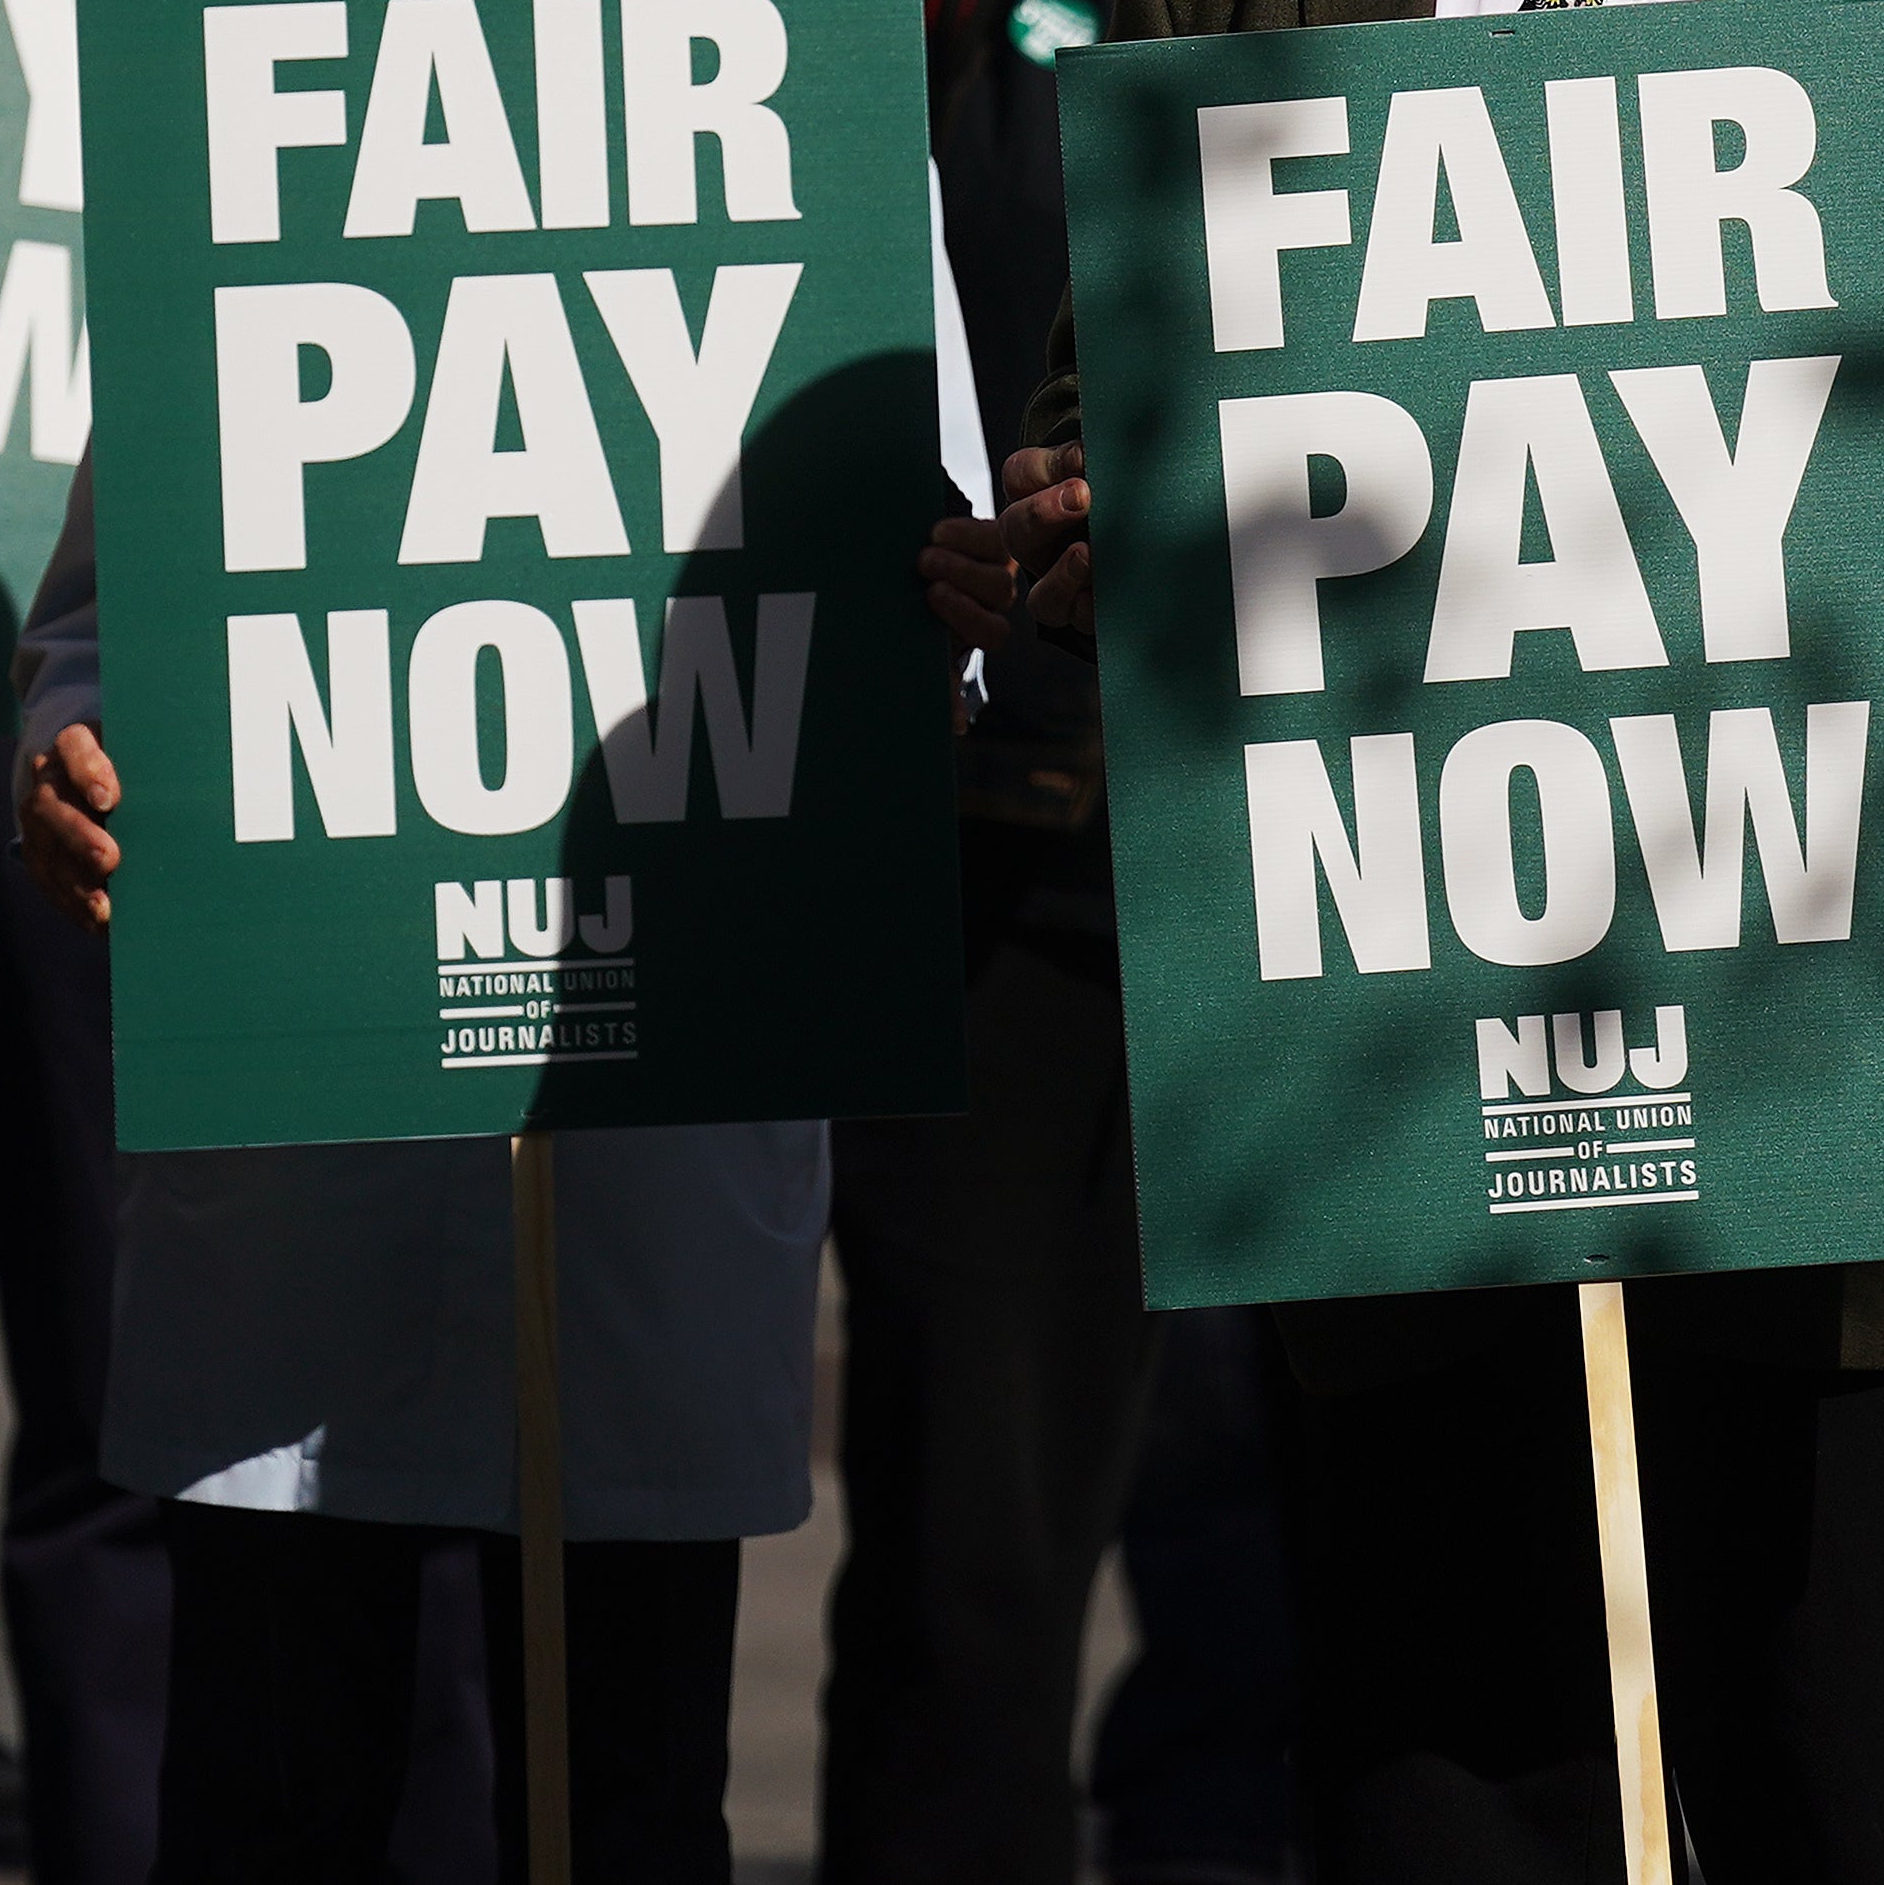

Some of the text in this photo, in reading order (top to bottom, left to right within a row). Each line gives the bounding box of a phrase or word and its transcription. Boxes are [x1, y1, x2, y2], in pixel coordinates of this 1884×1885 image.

[1196, 65, 1841, 353] FAIR
[213, 262, 805, 573] PAY
[1218, 355, 1843, 698] PAY
[226, 592, 817, 844] NOW
[1244, 699, 1872, 982] NOW
[434, 875, 633, 961] NUJ
[438, 969, 635, 997] NATIONAL UNION
[525, 999, 551, 1020] OF
[440, 1021, 638, 1055] JOURNALISTS
[1475, 1004, 1689, 1100] NUJ
[1483, 1105, 1692, 1139] NATIONAL UNION
[1577, 1140, 1603, 1160] OF
[1487, 1159, 1698, 1198] JOURNALISTS
